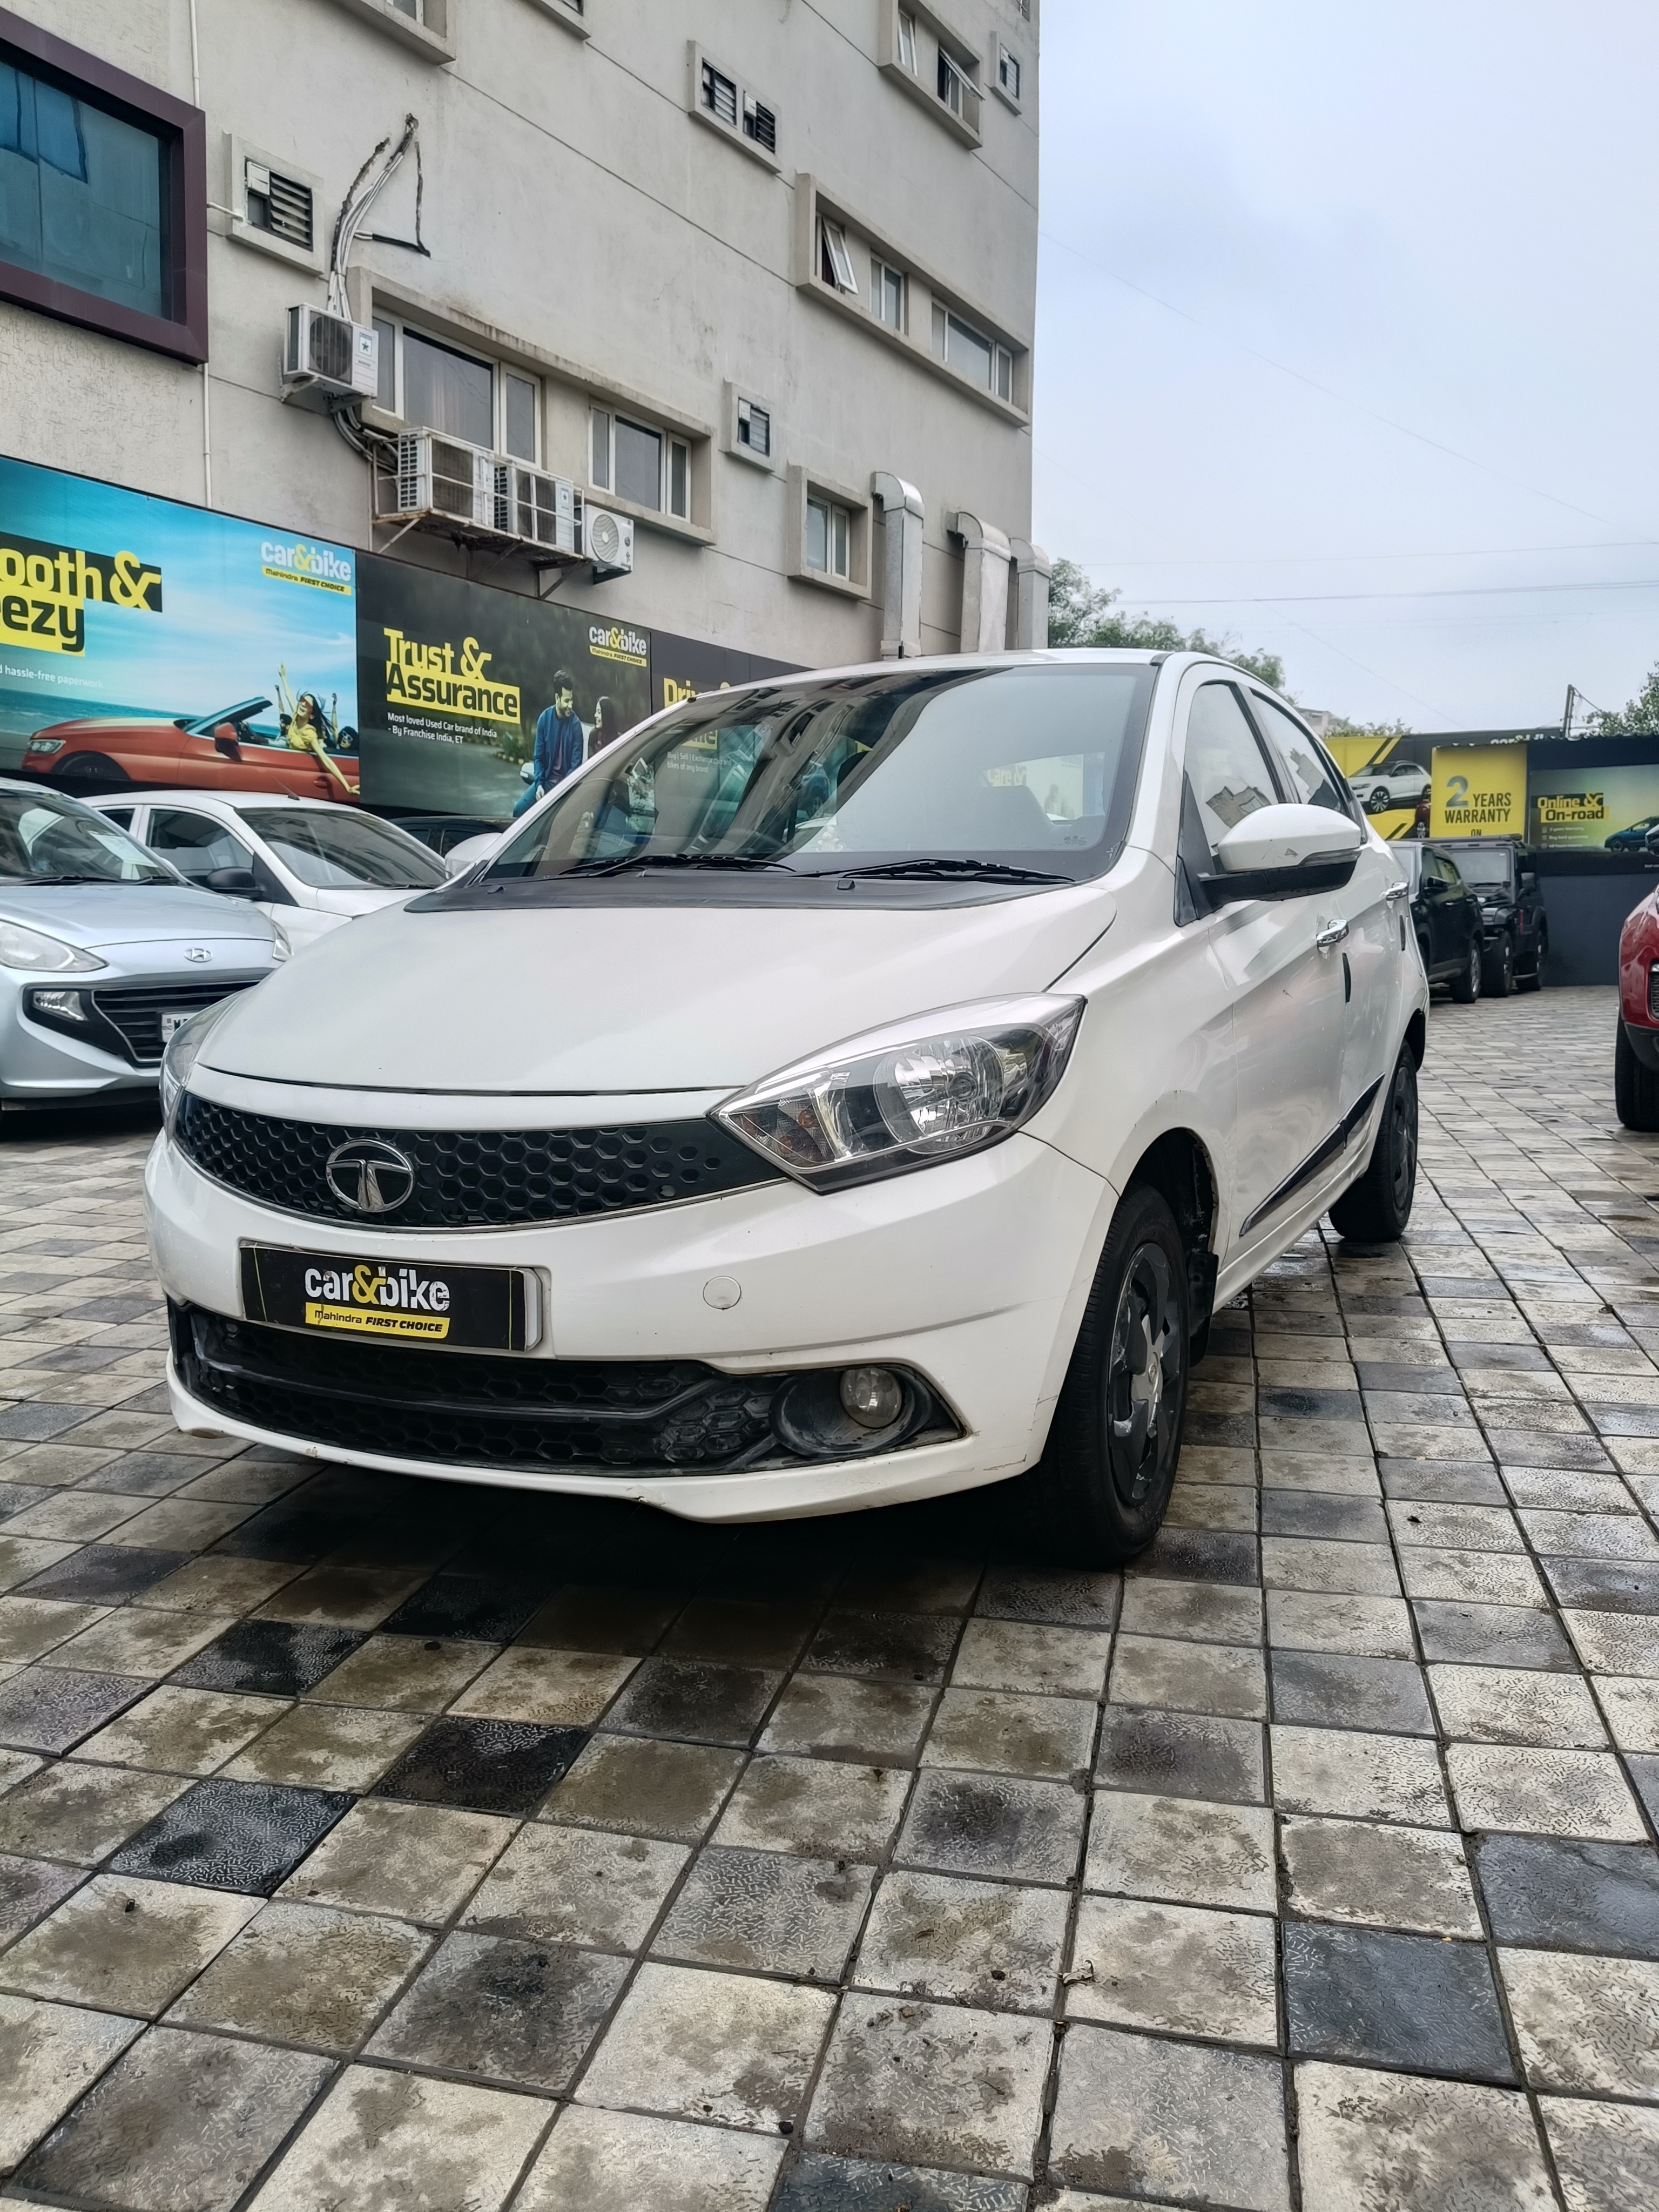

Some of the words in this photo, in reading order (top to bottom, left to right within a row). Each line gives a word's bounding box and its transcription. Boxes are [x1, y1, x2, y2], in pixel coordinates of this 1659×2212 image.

[261, 541, 352, 582] car&bike
[110, 550, 162, 611] &
[266, 568, 298, 582] Mahindra
[300, 576, 320, 586] FIRST
[321, 581, 345, 592] CHOICE
[0, 595, 84, 652] ezy
[383, 628, 454, 674] Trust
[460, 637, 492, 682] &
[589, 626, 646, 656] car&bike
[5, 665, 56, 682] hassle-free
[57, 676, 104, 688] paperwork
[386, 662, 518, 718] Assurance
[387, 712, 405, 723] Most
[406, 715, 424, 726] loved
[425, 719, 442, 729] Used
[443, 721, 454, 731] Car
[455, 723, 473, 734] brand
[474, 727, 482, 735] of
[482, 728, 497, 738] India
[392, 725, 402, 737] By
[403, 727, 435, 740] Franchise
[436, 732, 455, 744] India,
[455, 736, 464, 744] ET
[1446, 775, 1468, 808] 2
[1473, 792, 1512, 807] YEARS
[1537, 795, 1580, 809] Online
[1584, 791, 1603, 808] &
[1445, 808, 1511, 824] WARRANTY
[1546, 807, 1604, 821] On-road
[305, 1265, 450, 1312] car&bike
[314, 1310, 362, 1324] Mahindra
[365, 1317, 398, 1327] FIRST
[399, 1320, 443, 1332] CHOICE
